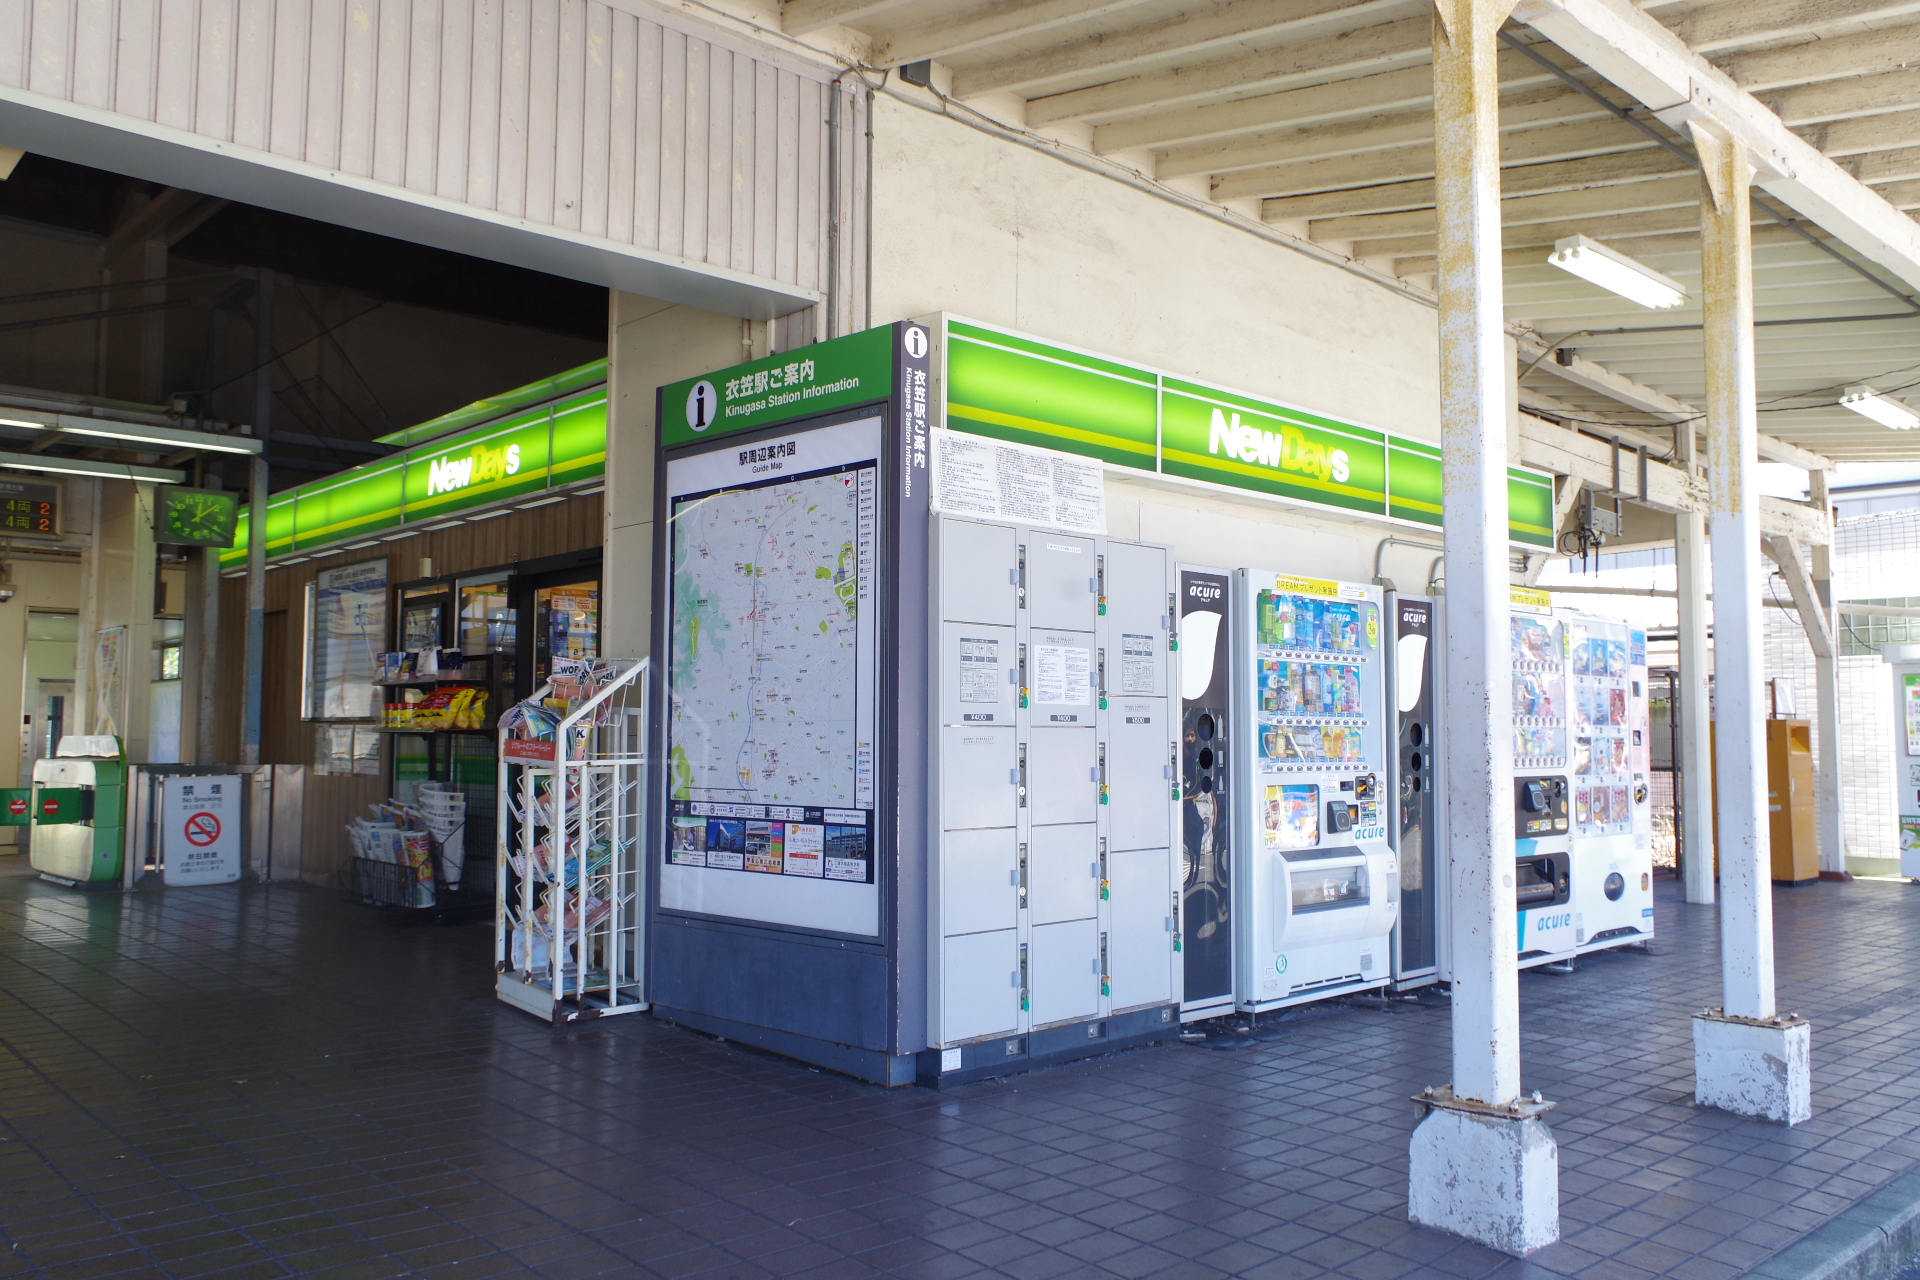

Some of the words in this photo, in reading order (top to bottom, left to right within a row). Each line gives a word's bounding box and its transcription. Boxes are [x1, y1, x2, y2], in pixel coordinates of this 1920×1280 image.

[725, 358, 815, 402] 衣笠駅ご案内
[725, 400, 766, 418] Kinugasa
[768, 391, 801, 408] Station
[802, 376, 859, 400] Information
[913, 369, 926, 469] 衣笠駅ご案内
[738, 441, 796, 466] 駅周辺案内図
[1208, 407, 1350, 483] NewDays
[427, 444, 520, 496] NewDays
[752, 464, 770, 474] Guide
[770, 462, 783, 471] Map
[904, 447, 912, 498] Information
[40, 502, 51, 515] 2
[39, 518, 50, 531] 2
[1189, 586, 1221, 599] acure
[1403, 612, 1427, 624] acure
[1355, 826, 1385, 840] acure
[1537, 913, 1571, 931] acure
